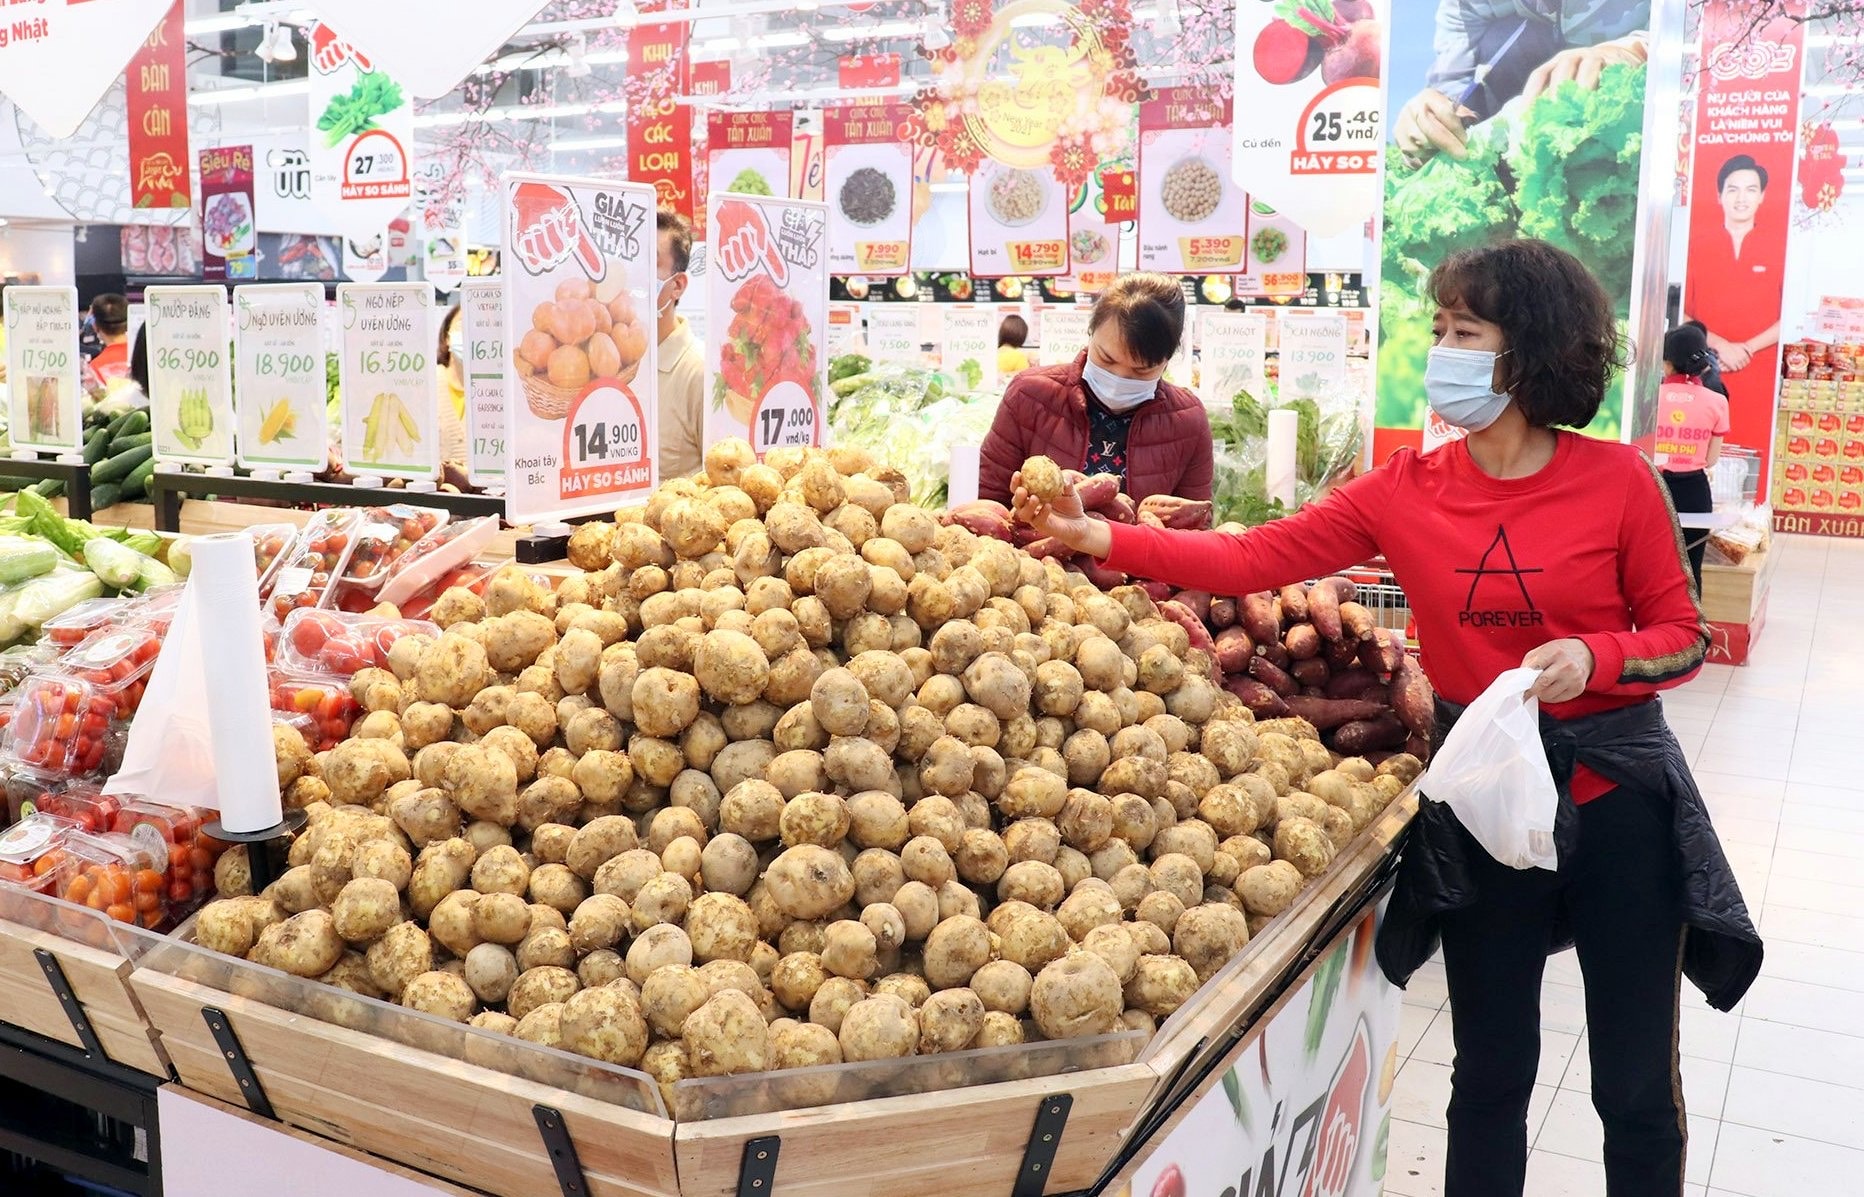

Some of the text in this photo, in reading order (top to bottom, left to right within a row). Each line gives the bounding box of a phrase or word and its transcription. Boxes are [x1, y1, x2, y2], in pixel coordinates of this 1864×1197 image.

[12, 17, 48, 43] Nhật
[141, 60, 170, 92] BÀN
[143, 104, 171, 136] CÂN
[644, 121, 674, 143] CÁC
[639, 152, 679, 173] LOẠI
[1336, 155, 1364, 170] SO
[365, 184, 379, 196] SO
[866, 244, 900, 259] 7.990
[1015, 243, 1060, 260] 14.790
[1190, 239, 1231, 255] 5.390
[22, 349, 67, 371] 17.900
[157, 346, 219, 373] 36.900
[256, 352, 314, 378] 18.900
[361, 351, 425, 374] 16.500
[761, 407, 813, 446] 17.000
[574, 422, 638, 461] 14.900
[514, 455, 557, 470] Khoai tây
[528, 472, 545, 485] Bắc
[593, 470, 612, 488] SO
[614, 465, 650, 486] SÁNH
[1774, 513, 1864, 537] TÂN XUÂ
[1459, 611, 1544, 627] POREVER
